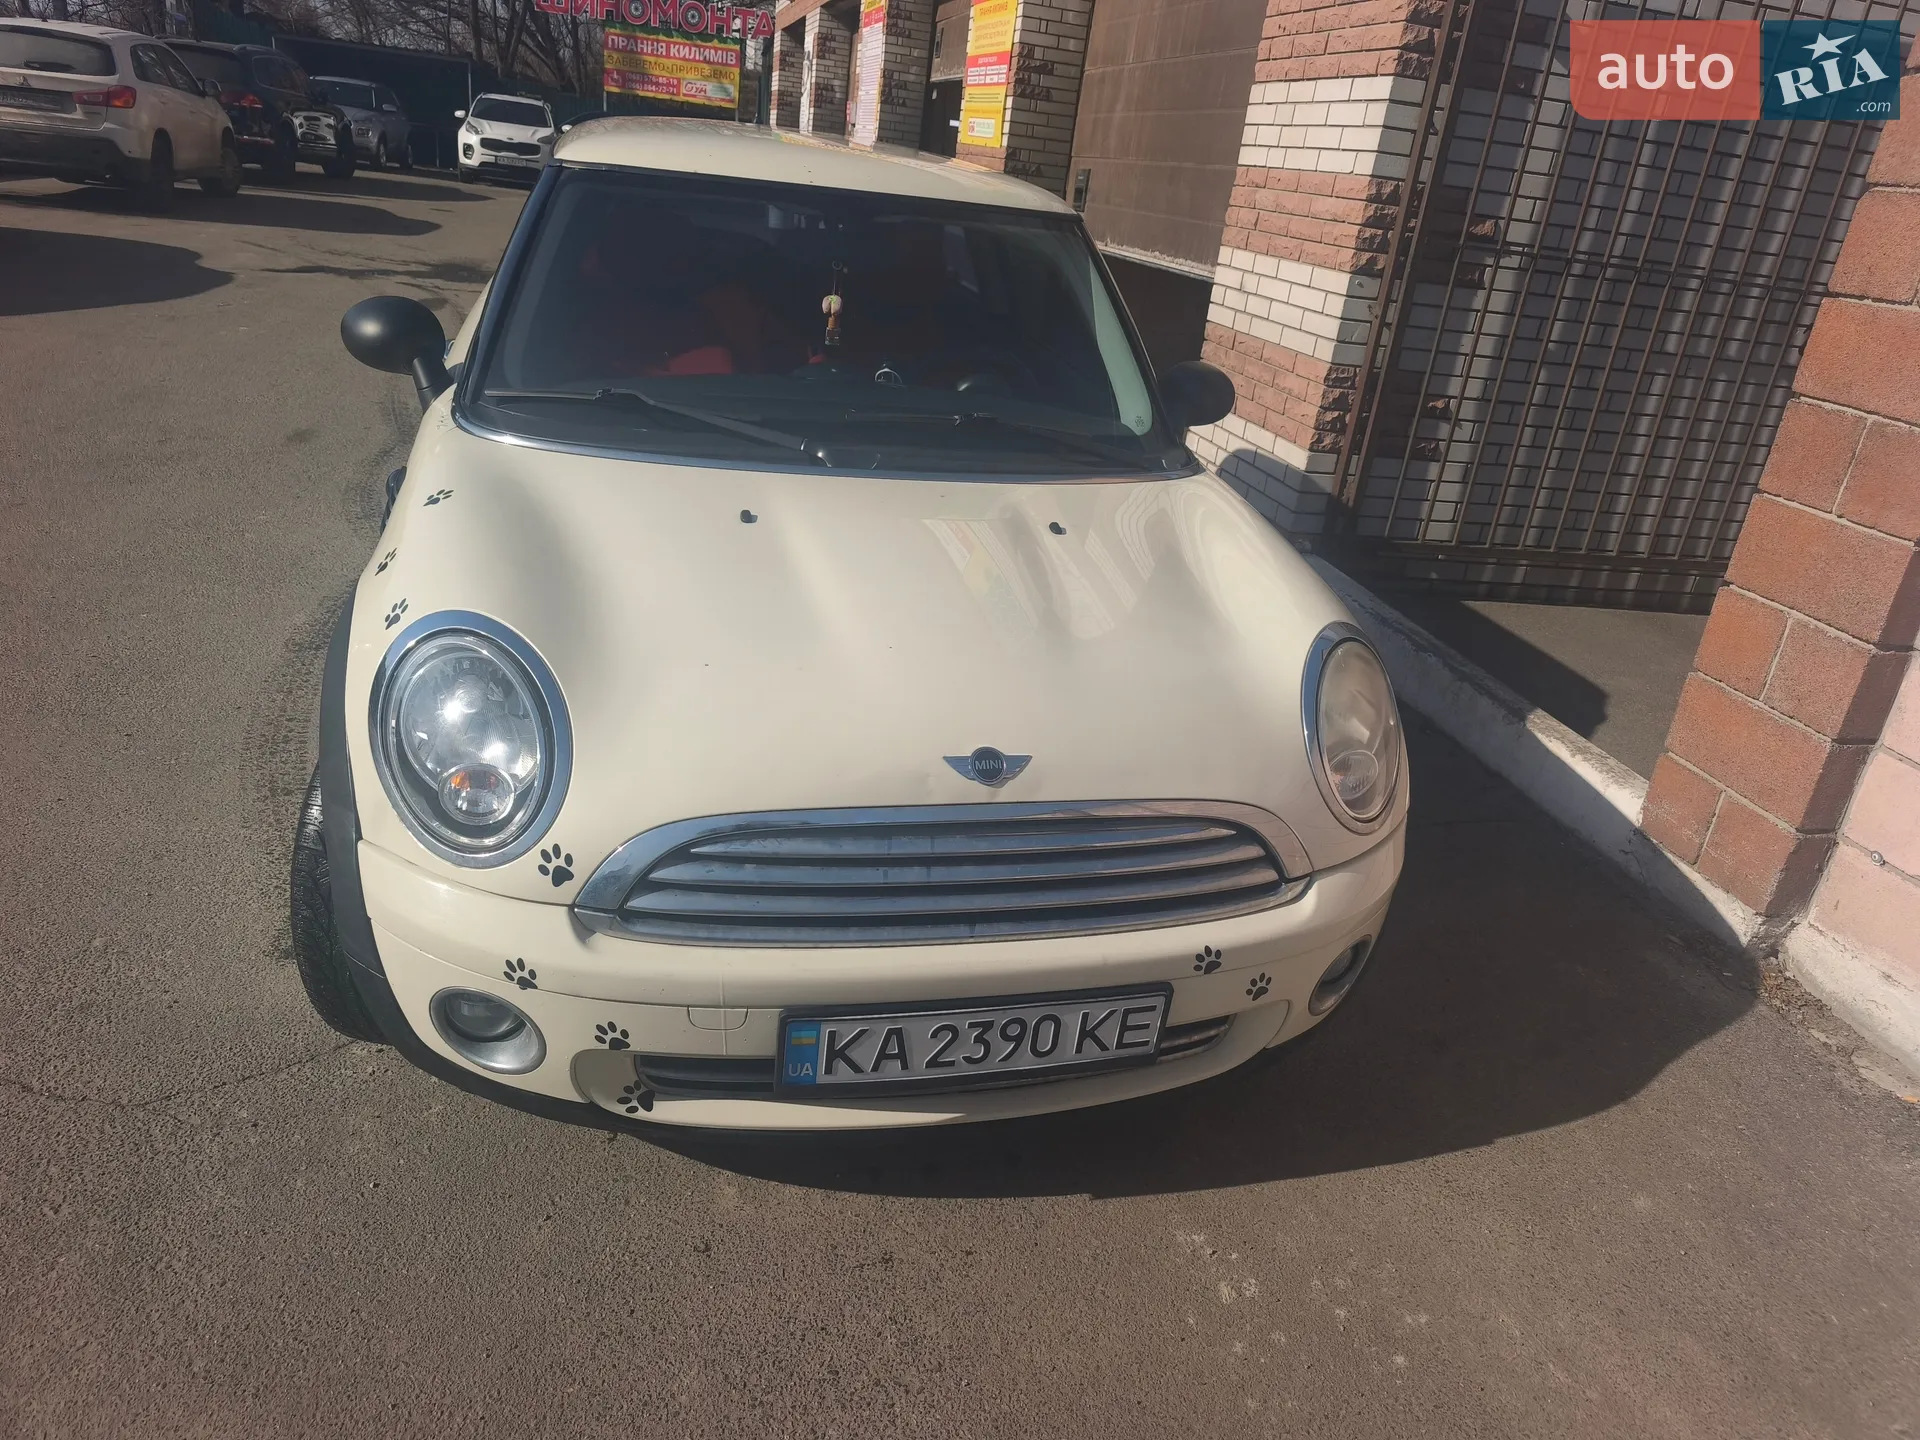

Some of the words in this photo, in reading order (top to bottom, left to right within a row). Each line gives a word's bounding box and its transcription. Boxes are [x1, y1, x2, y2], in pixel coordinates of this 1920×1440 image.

[608, 35, 667, 56] ПРАННЯ
[670, 44, 737, 65] КИЛИМІВ
[975, 759, 1003, 770] MINI
[822, 1026, 910, 1076] KA
[924, 1013, 1063, 1069] 2390
[1073, 1004, 1157, 1056] KE
[787, 1062, 814, 1078] UA
